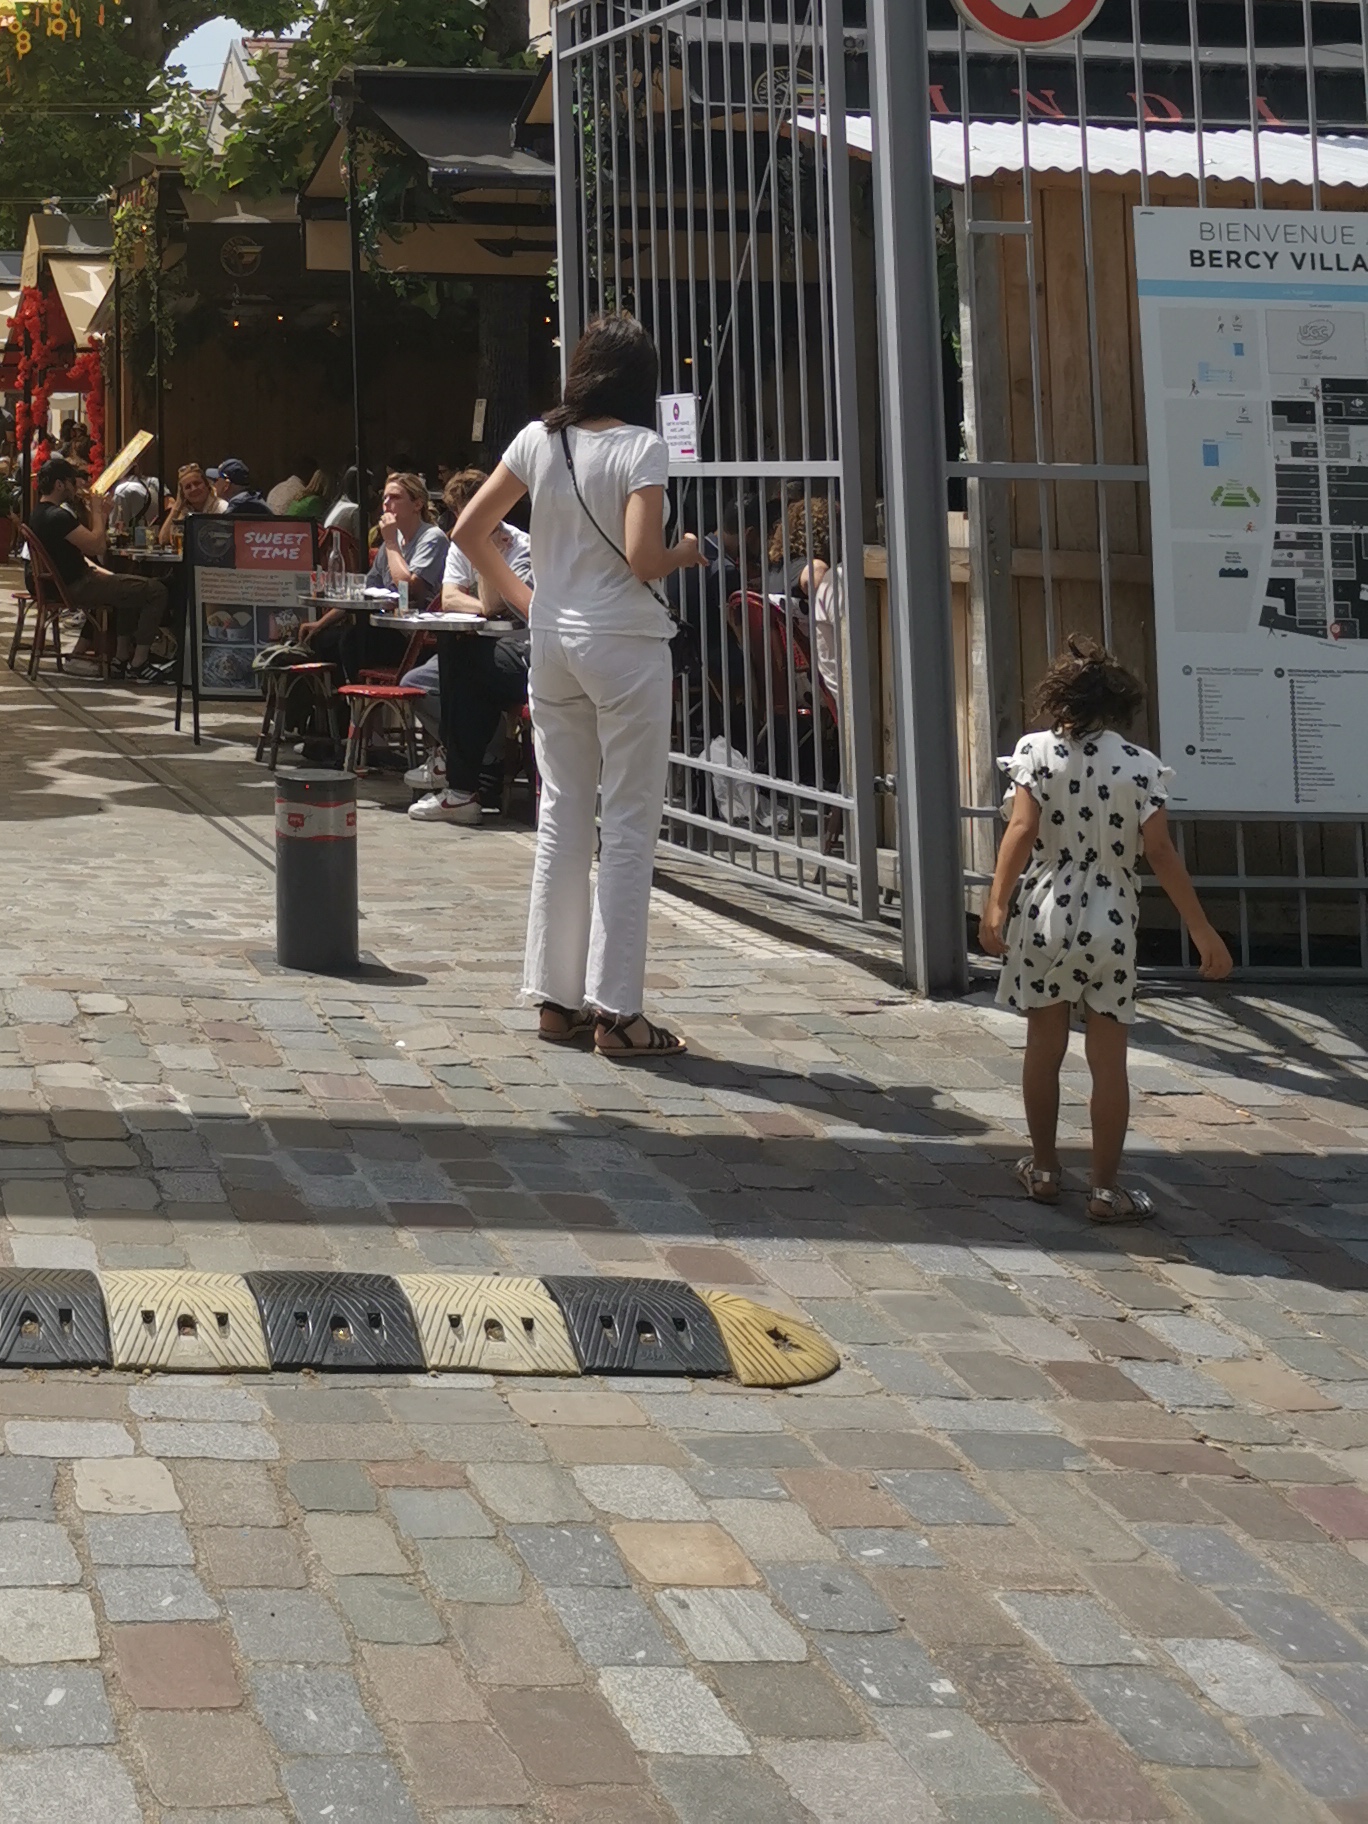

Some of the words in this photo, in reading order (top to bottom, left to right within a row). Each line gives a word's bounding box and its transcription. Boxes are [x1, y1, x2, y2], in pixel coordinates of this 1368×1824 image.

[1199, 221, 1356, 245] BIENVENUE
[1189, 249, 1279, 270] BERCY
[244, 531, 309, 545] SWEET
[250, 546, 301, 560] TIME
